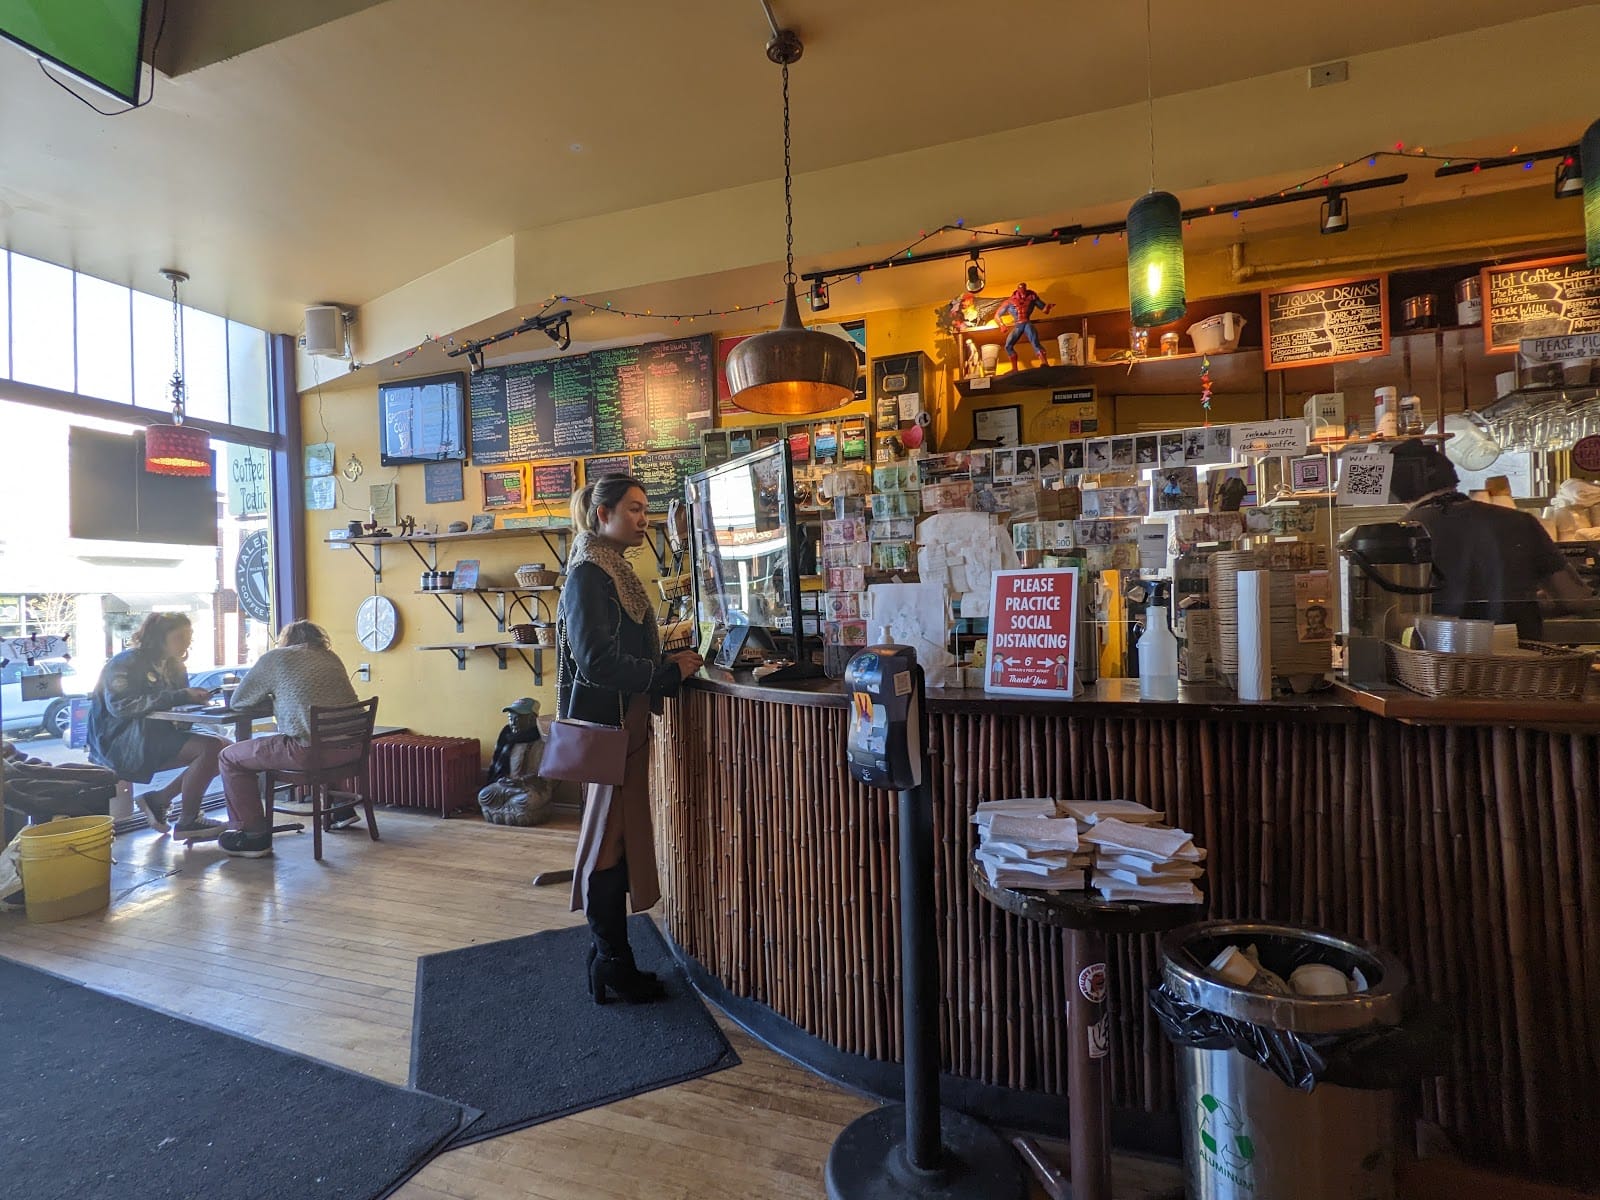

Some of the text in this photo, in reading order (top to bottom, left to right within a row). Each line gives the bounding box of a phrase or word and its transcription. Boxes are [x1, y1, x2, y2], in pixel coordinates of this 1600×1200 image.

[1492, 273, 1516, 288] Hot
[1521, 268, 1563, 284] Coffee
[1277, 284, 1379, 308] LIQUOR DRINKS
[1338, 298, 1366, 308] COLD
[1282, 307, 1302, 317] HOT
[1536, 337, 1573, 352] PLEASE
[233, 456, 265, 482] Coffee
[1013, 578, 1055, 593] PLEASE
[1005, 596, 1061, 611] PRACTICE
[1010, 615, 1053, 630] SOCIAL
[995, 633, 1067, 649] DISTANCING
[1009, 674, 1048, 687] Thank You
[1200, 1149, 1254, 1193] ALUMINUM
